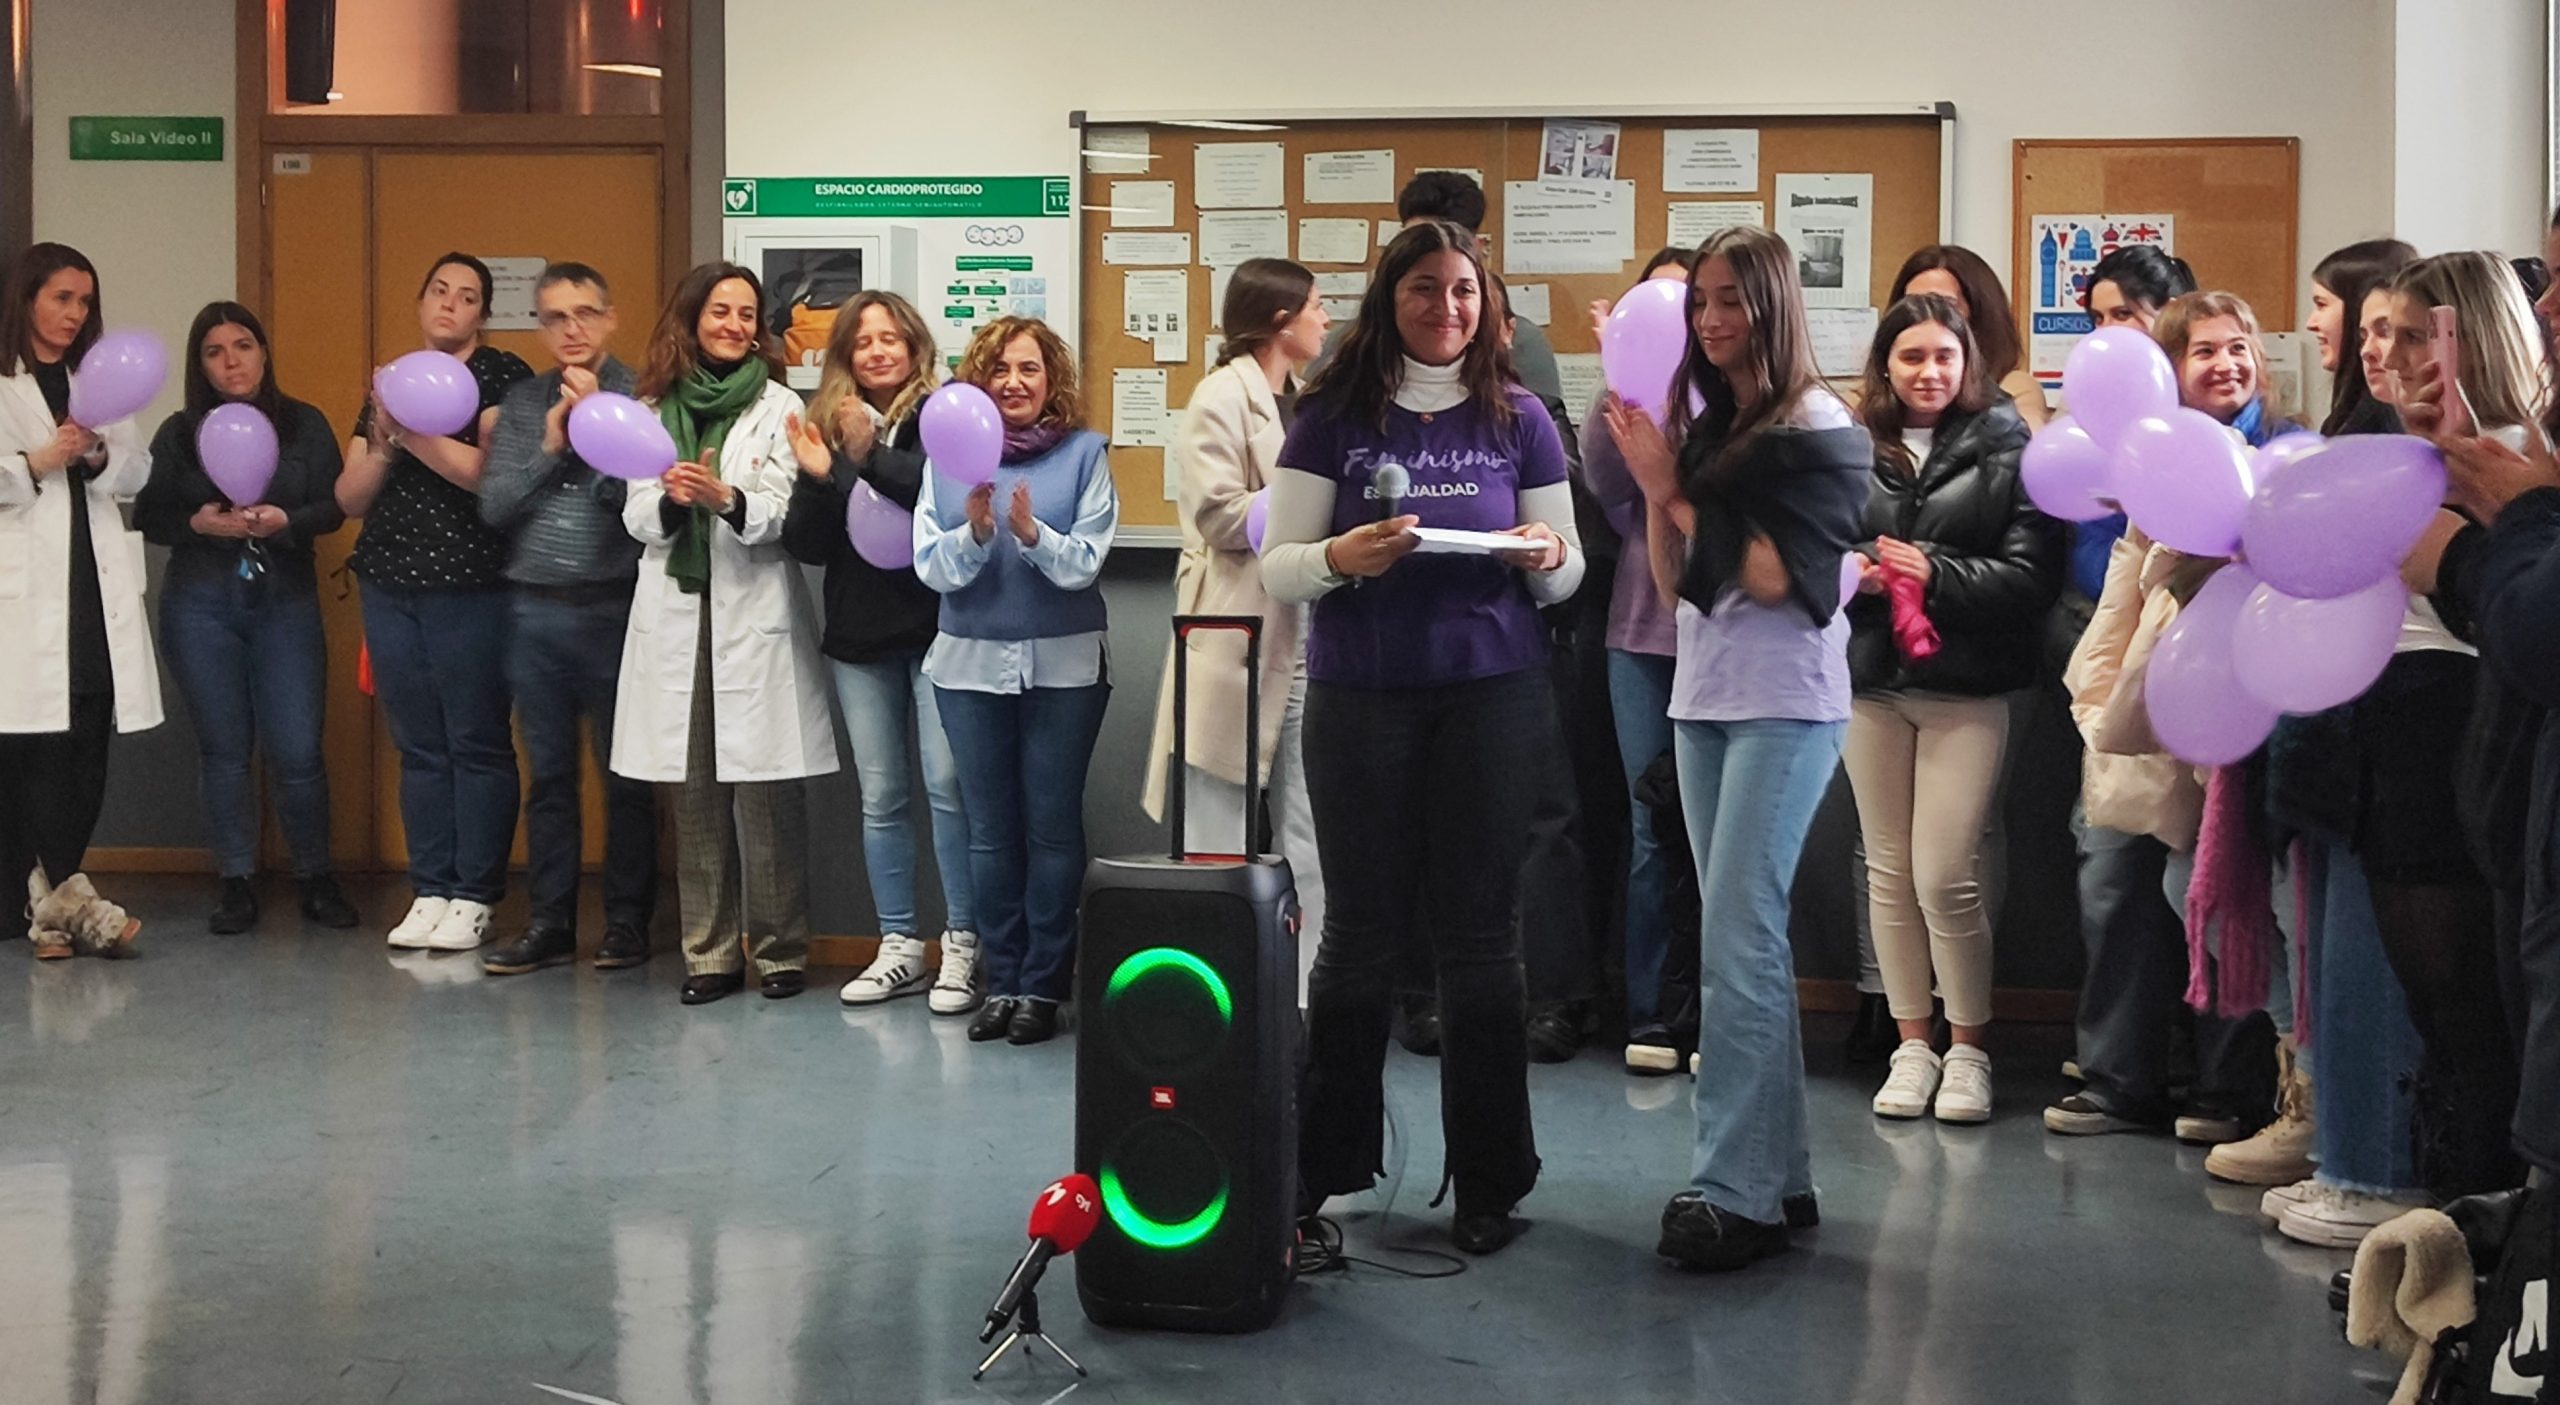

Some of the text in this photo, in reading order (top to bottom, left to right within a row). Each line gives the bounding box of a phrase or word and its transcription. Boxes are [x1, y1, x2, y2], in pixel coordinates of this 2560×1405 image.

[111, 132, 145, 145] Sala
[150, 132, 197, 145] Video
[814, 183, 983, 196] ESPACIO CARDIOPROTEGIDO
[2038, 316, 2092, 332] CURSOS
